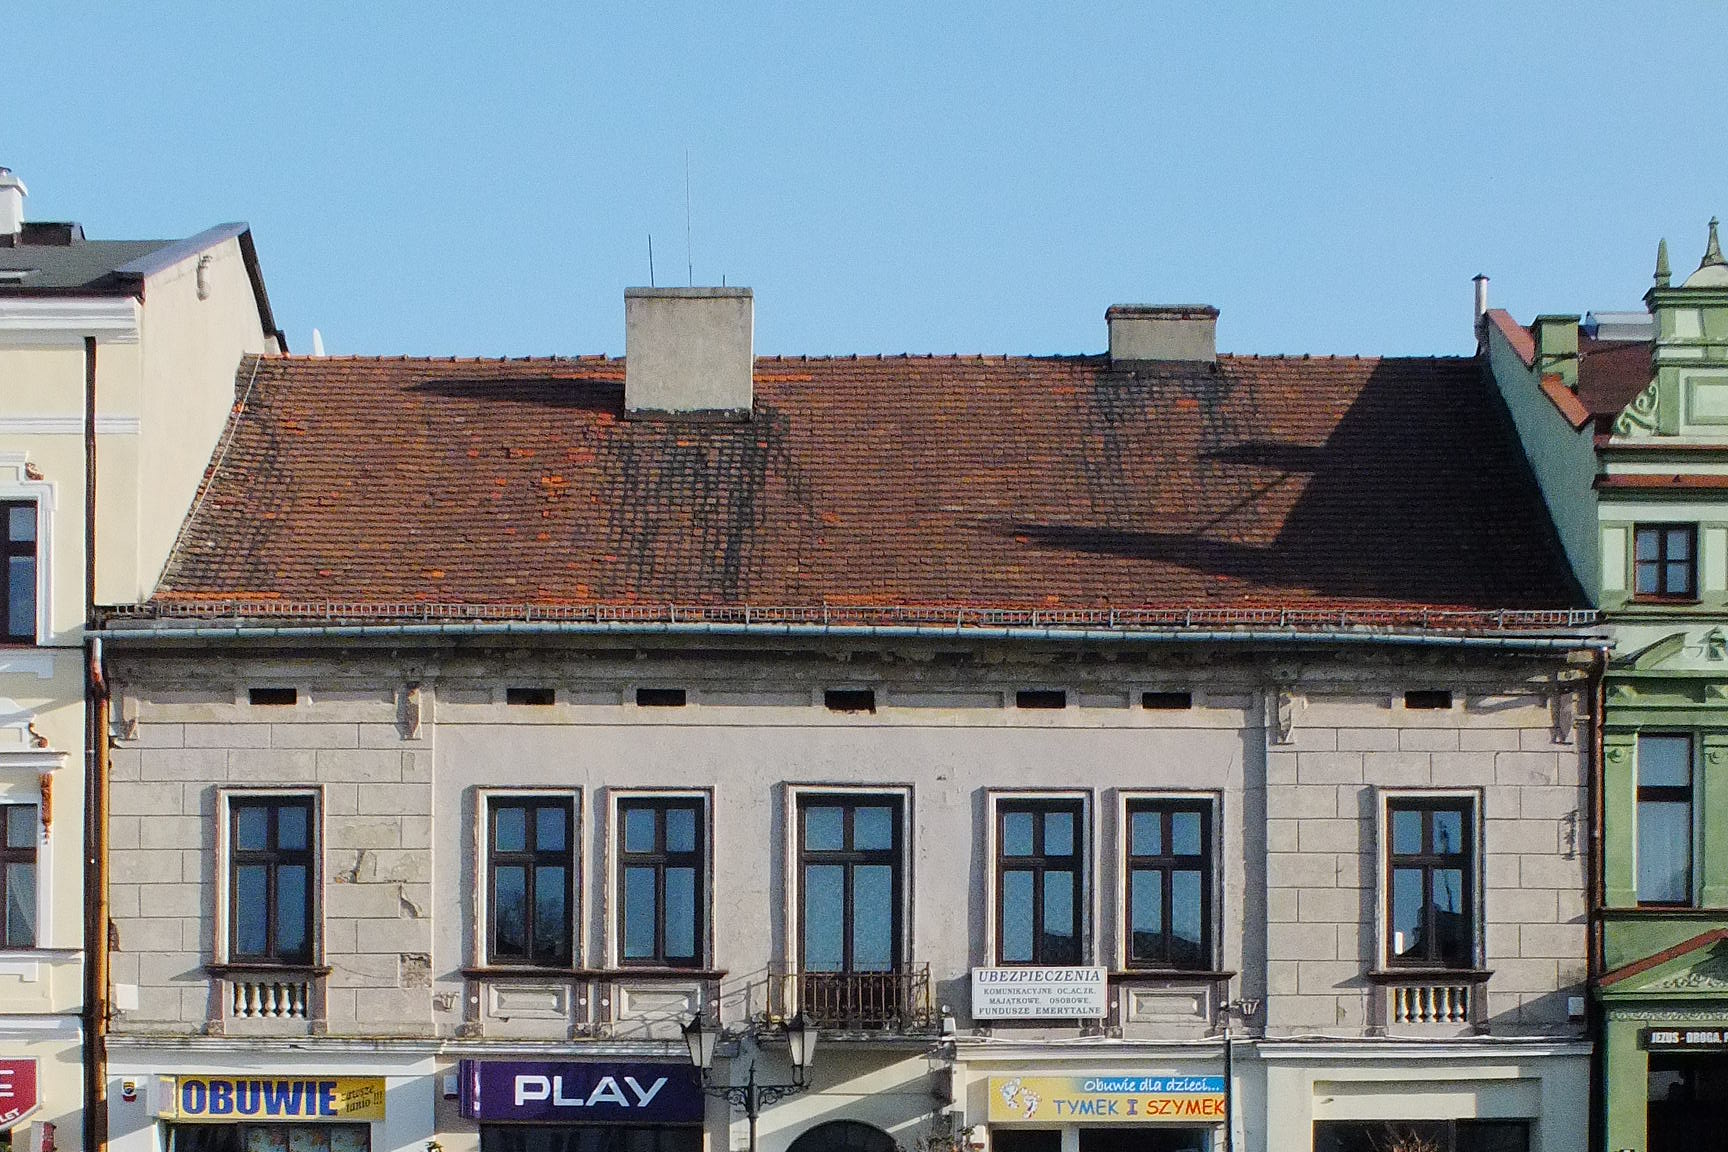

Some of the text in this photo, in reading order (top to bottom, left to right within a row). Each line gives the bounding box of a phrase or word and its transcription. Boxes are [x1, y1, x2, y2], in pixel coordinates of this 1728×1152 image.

[979, 970, 1100, 983] UBEZPIECZENIA
[979, 1007, 1101, 1015] FUNDUSZE EMERYTALNE
[1651, 1031, 1680, 1044] JEZUS
[514, 1074, 668, 1107] PLAY
[1084, 1078, 1136, 1092] Obuwie
[1139, 1078, 1162, 1092] dla
[181, 1079, 338, 1116] OBUWIE
[1053, 1098, 1225, 1116] TYMEK I SZYMEK
